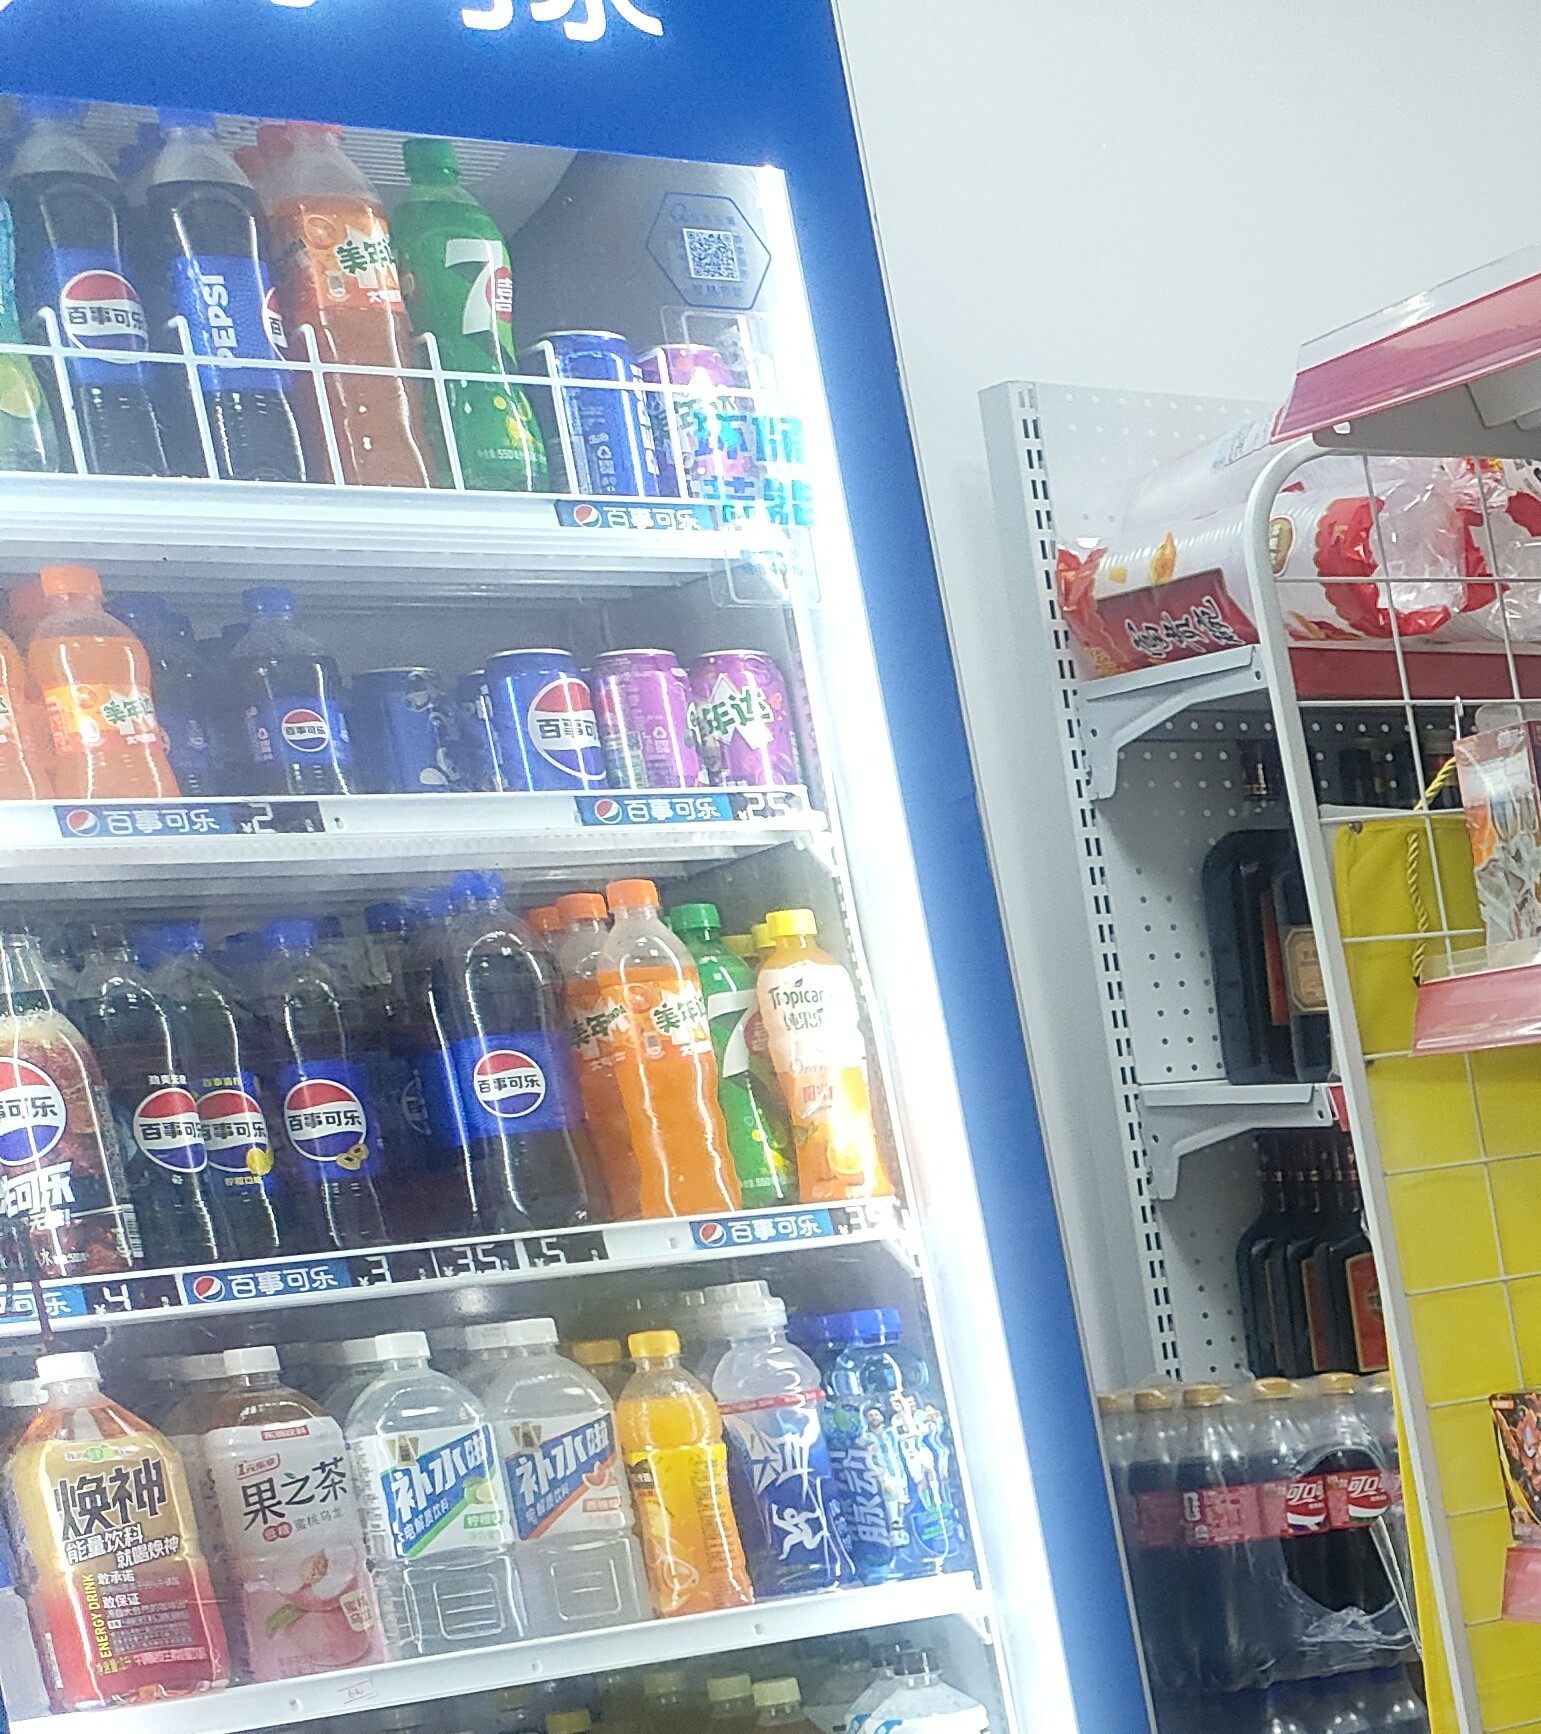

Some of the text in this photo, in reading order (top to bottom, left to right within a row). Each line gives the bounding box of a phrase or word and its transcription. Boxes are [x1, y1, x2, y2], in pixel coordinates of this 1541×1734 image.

[104, 807, 222, 836] 百事可乐
[624, 796, 722, 824] 百事可乐
[729, 1213, 824, 1244] 百事可乐
[227, 1269, 339, 1298] 百事可乐
[515, 1427, 609, 1508] 补水啦
[54, 1458, 167, 1542] 焕神
[241, 1456, 349, 1530] 果之茶
[66, 1525, 144, 1564] 能量饮料
[116, 1535, 180, 1569] 就喝焕神
